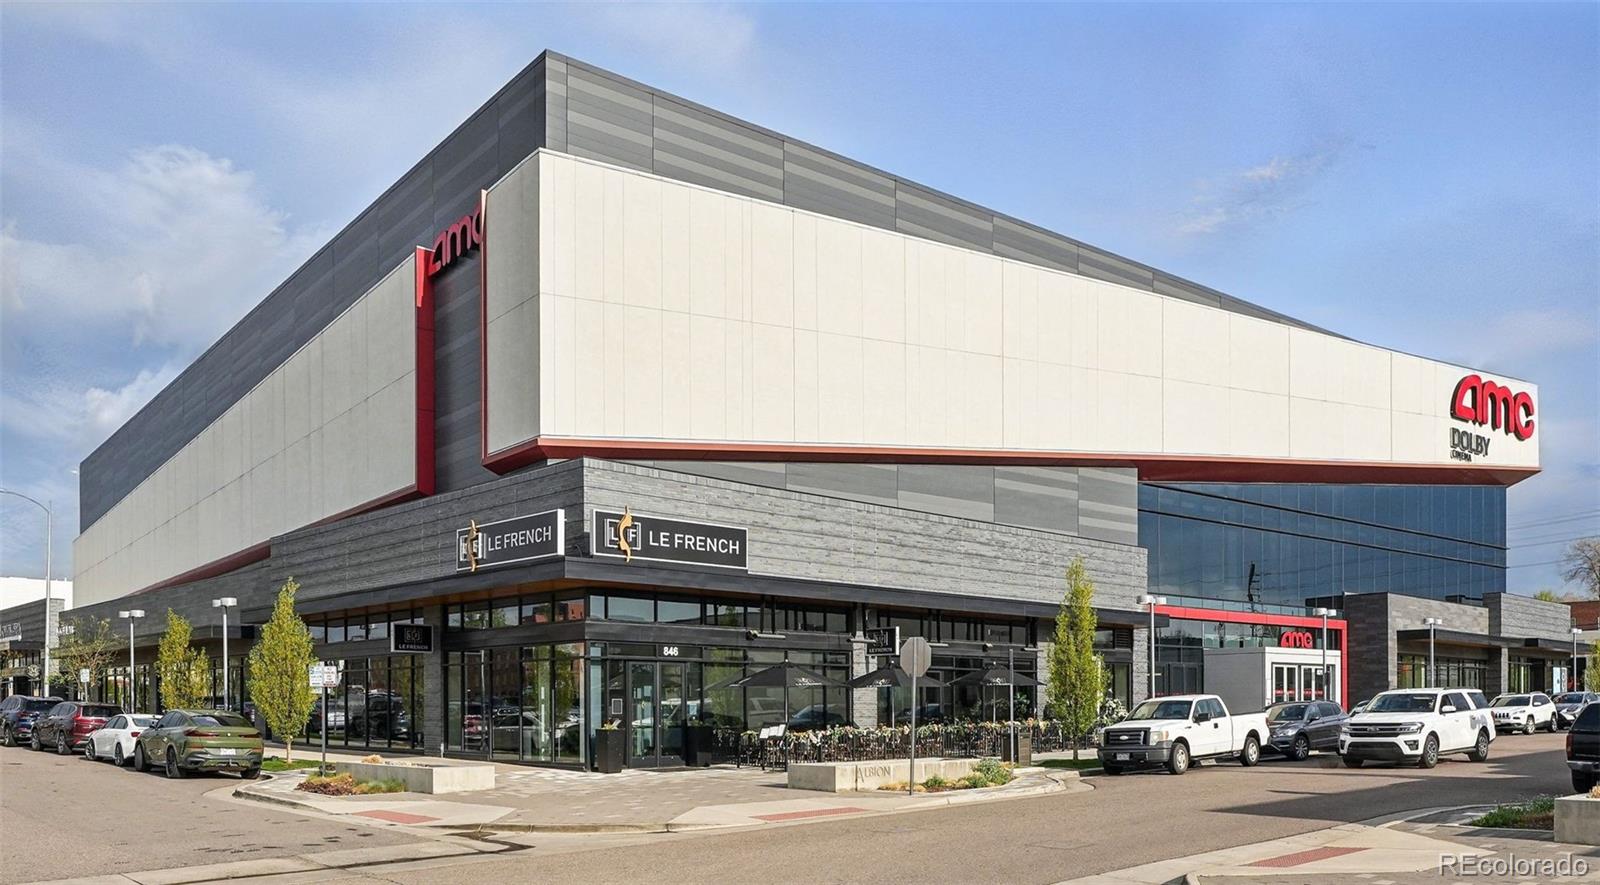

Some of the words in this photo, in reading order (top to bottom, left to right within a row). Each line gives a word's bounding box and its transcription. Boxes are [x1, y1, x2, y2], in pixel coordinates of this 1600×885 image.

[1450, 374, 1535, 441] amc
[1450, 427, 1490, 457] DOLBY
[488, 535, 502, 551] LE
[503, 525, 552, 549] FRENCH
[649, 530, 670, 547] LE
[674, 533, 740, 555] FRENCH
[663, 646, 679, 657] 846
[1281, 631, 1313, 649] amc
[855, 766, 891, 783] ALBION
